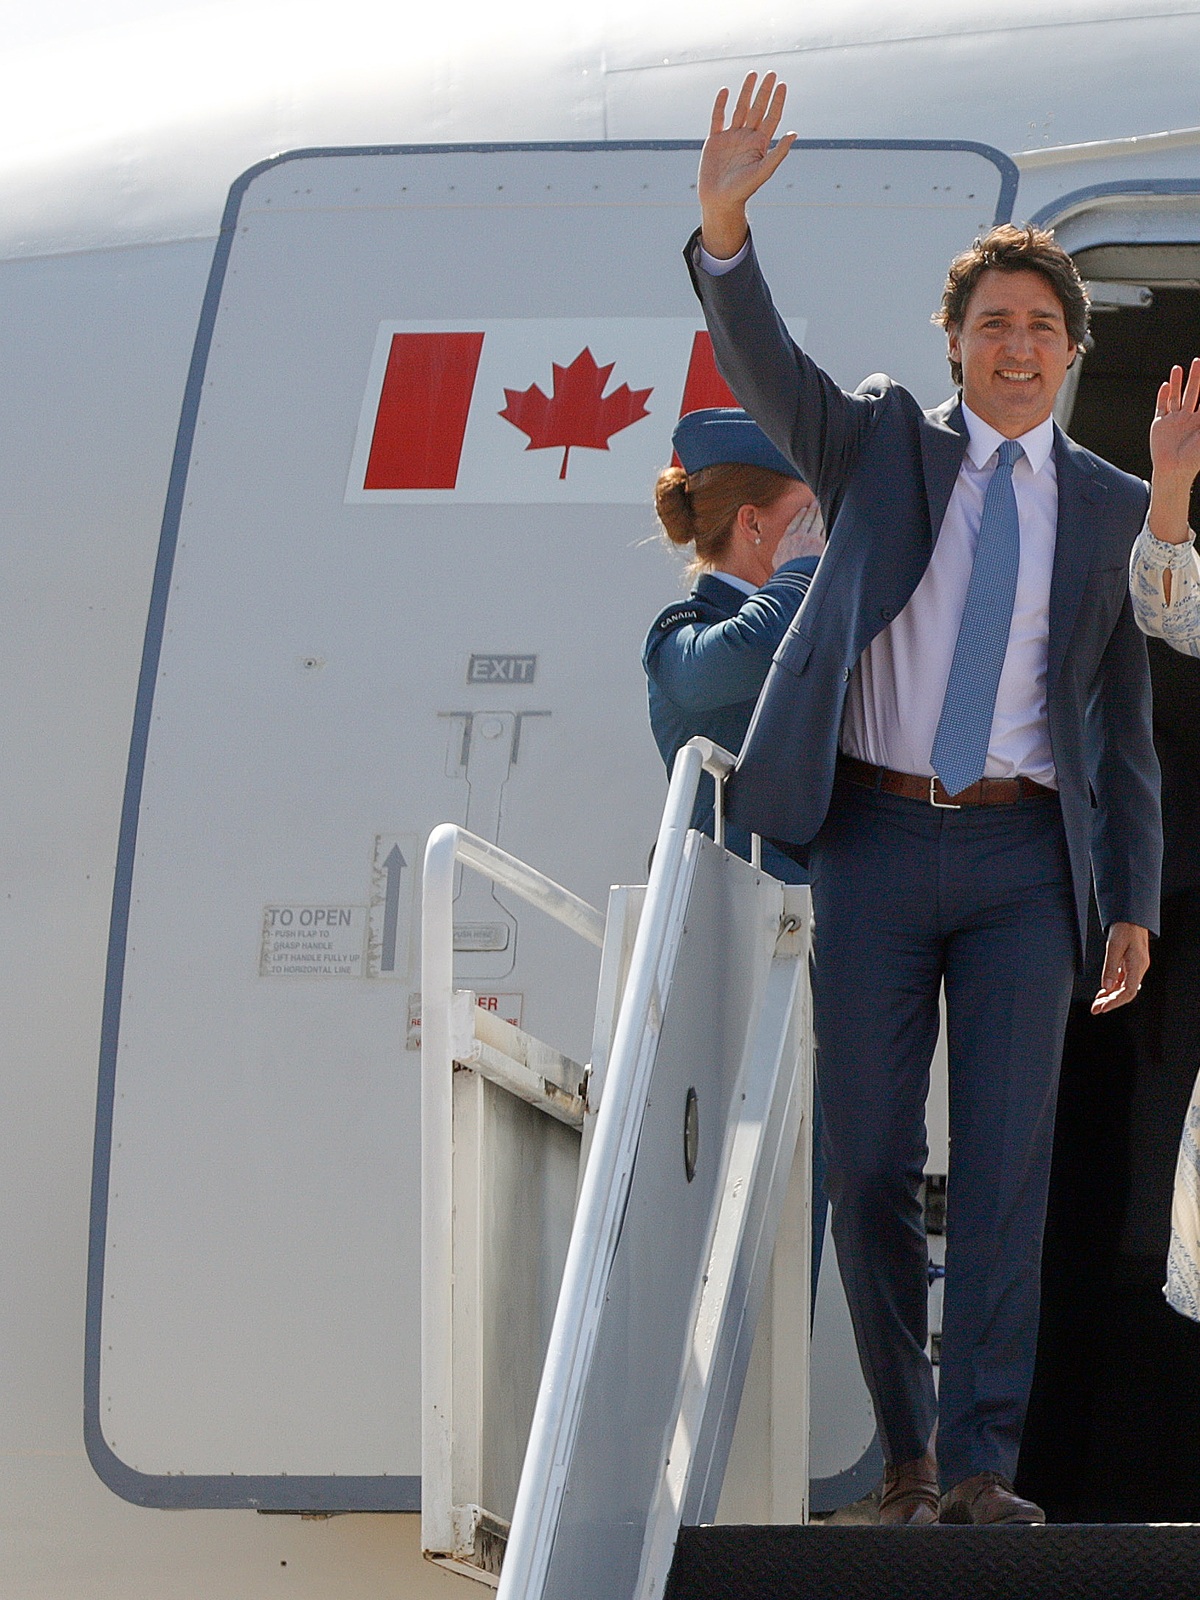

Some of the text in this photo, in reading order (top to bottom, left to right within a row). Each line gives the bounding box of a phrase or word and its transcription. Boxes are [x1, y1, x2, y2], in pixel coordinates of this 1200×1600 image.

[660, 610, 698, 629] CANADA
[472, 659, 534, 680] EXIT
[268, 909, 352, 926] TO OPEN
[274, 929, 297, 938] PUSH
[298, 929, 318, 938] FLAP
[319, 929, 330, 938] TO
[273, 941, 334, 951] GRASP HANDLE
[272, 953, 289, 962] LIFT
[290, 953, 322, 962] HANDLE
[323, 953, 348, 962] FULLY
[349, 953, 361, 962] UP
[271, 965, 352, 974] TO HORIZONTAL LINE
